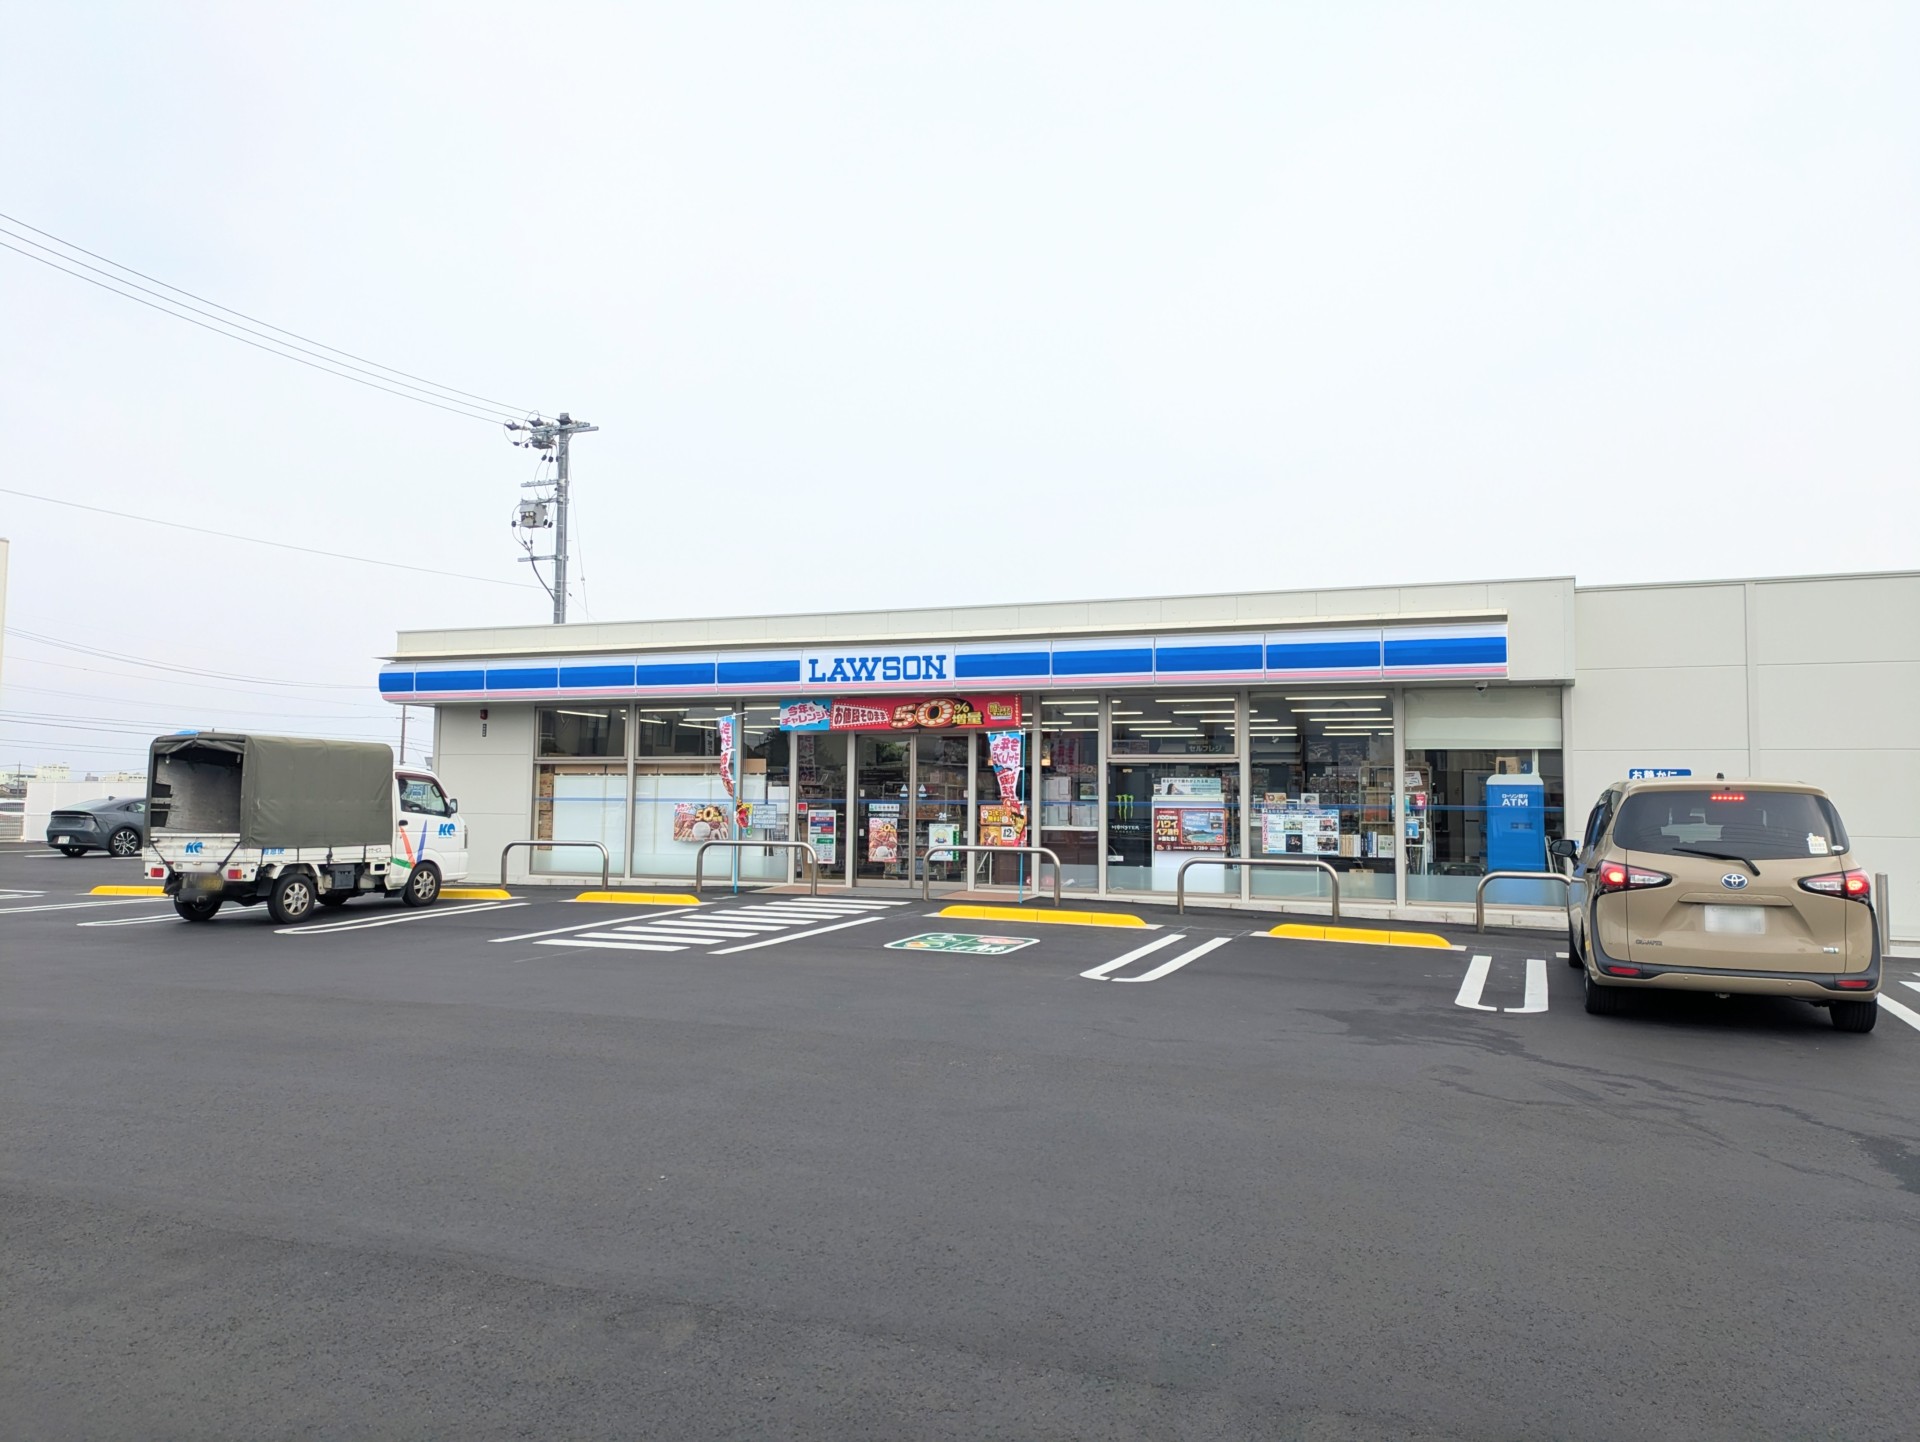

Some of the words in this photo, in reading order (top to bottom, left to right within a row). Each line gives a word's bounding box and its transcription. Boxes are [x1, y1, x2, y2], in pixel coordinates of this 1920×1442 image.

[808, 654, 947, 682] LAWSON
[787, 704, 816, 717] 今年も
[834, 706, 886, 725] お値段そのまま
[952, 711, 983, 725] 増量
[1501, 798, 1529, 807] ATM
[1156, 820, 1178, 828] ハワイ
